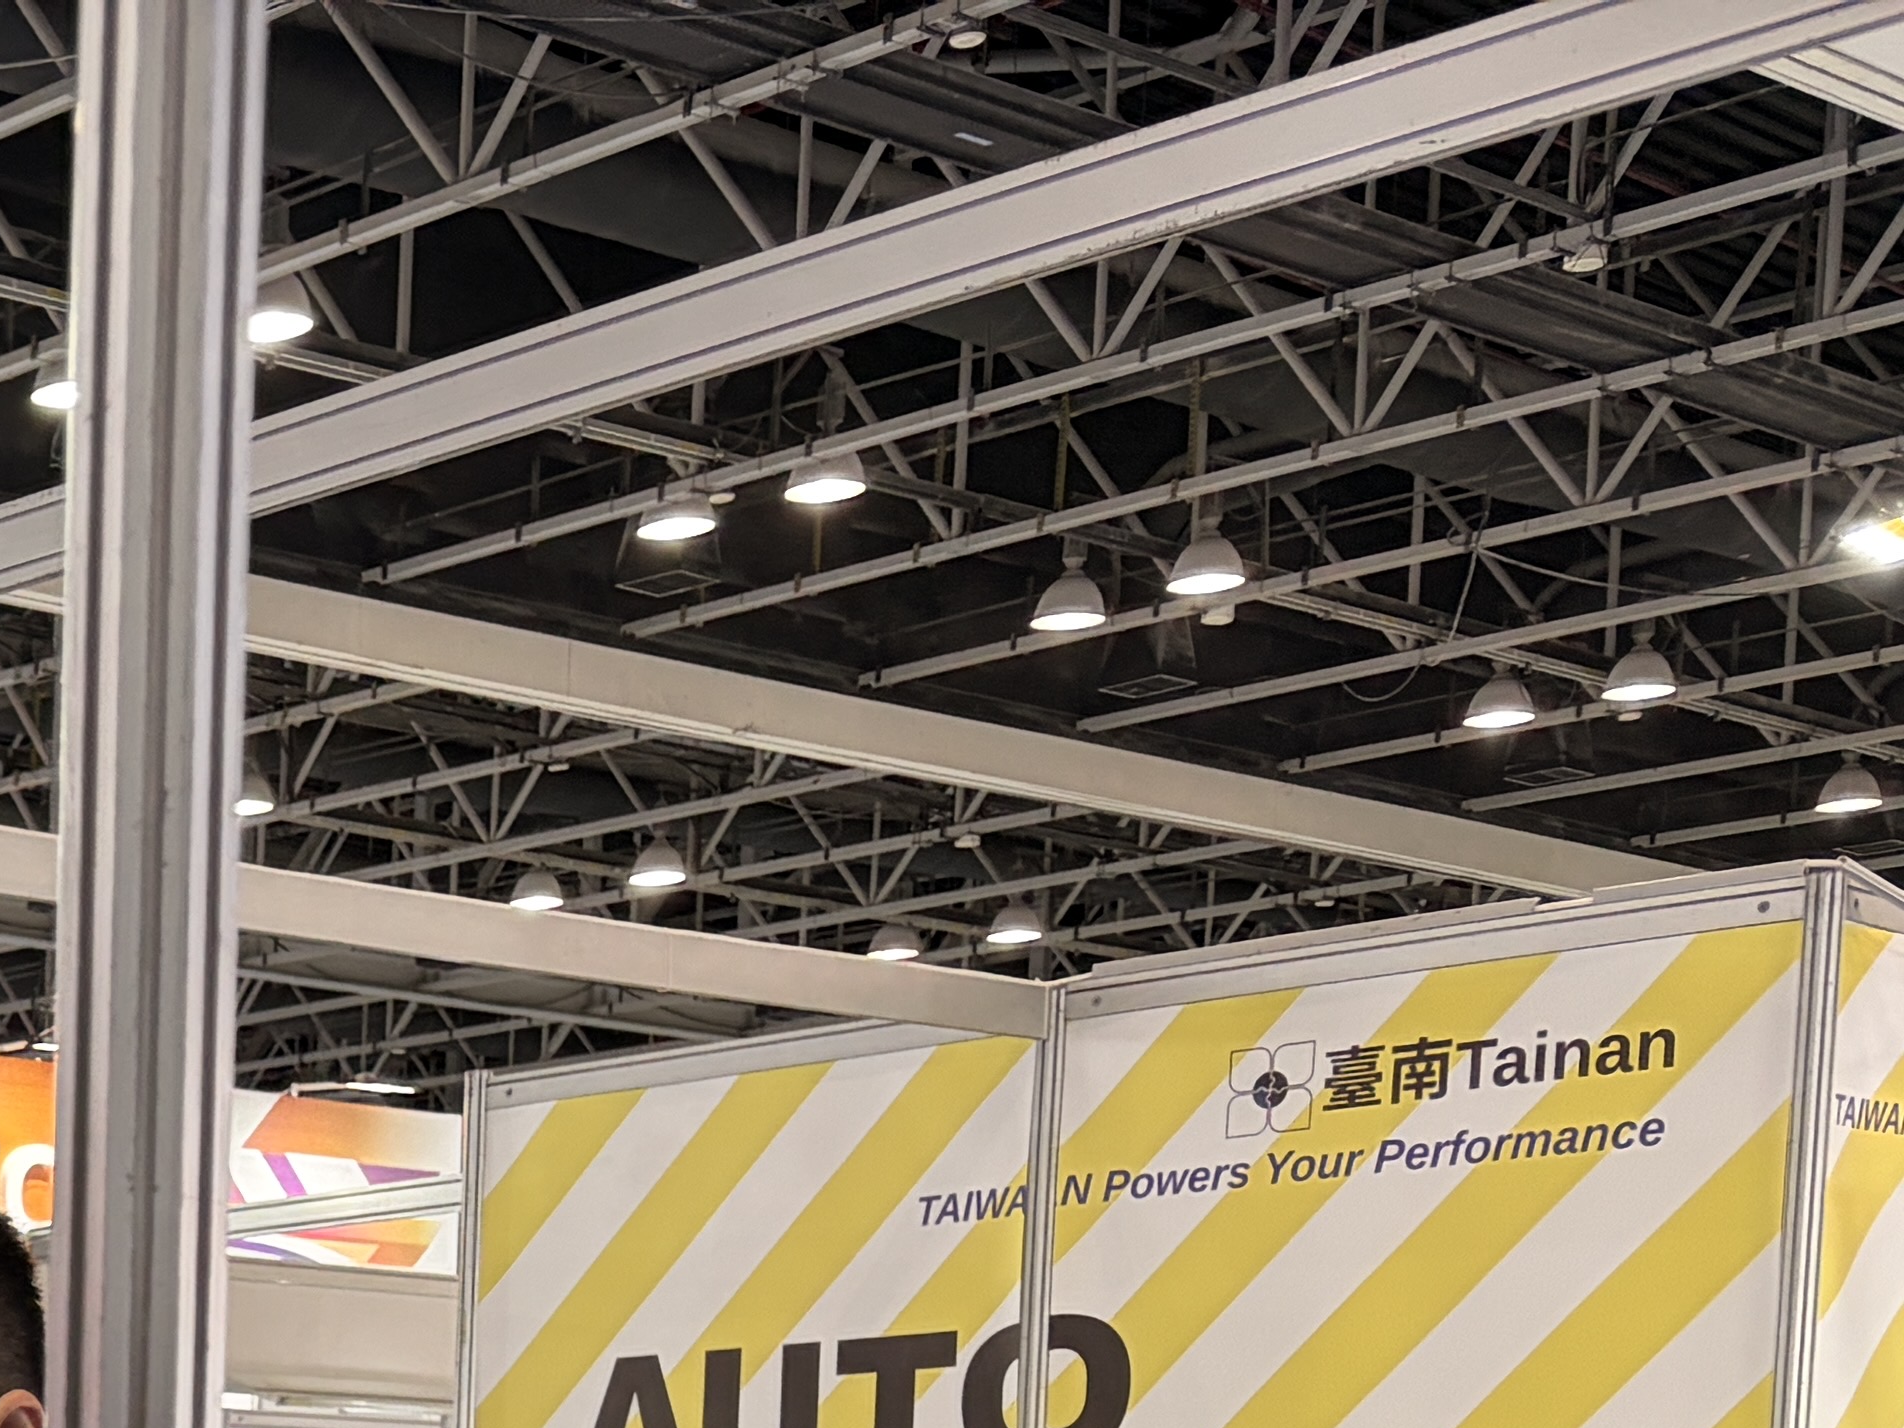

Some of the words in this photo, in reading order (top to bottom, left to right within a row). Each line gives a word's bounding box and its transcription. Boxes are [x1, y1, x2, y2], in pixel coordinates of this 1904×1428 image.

[1835, 1092, 1904, 1136] TAIWA
[1102, 1162, 1251, 1204] Powers
[1266, 1145, 1364, 1188] Your
[1374, 1116, 1666, 1176] Performance
